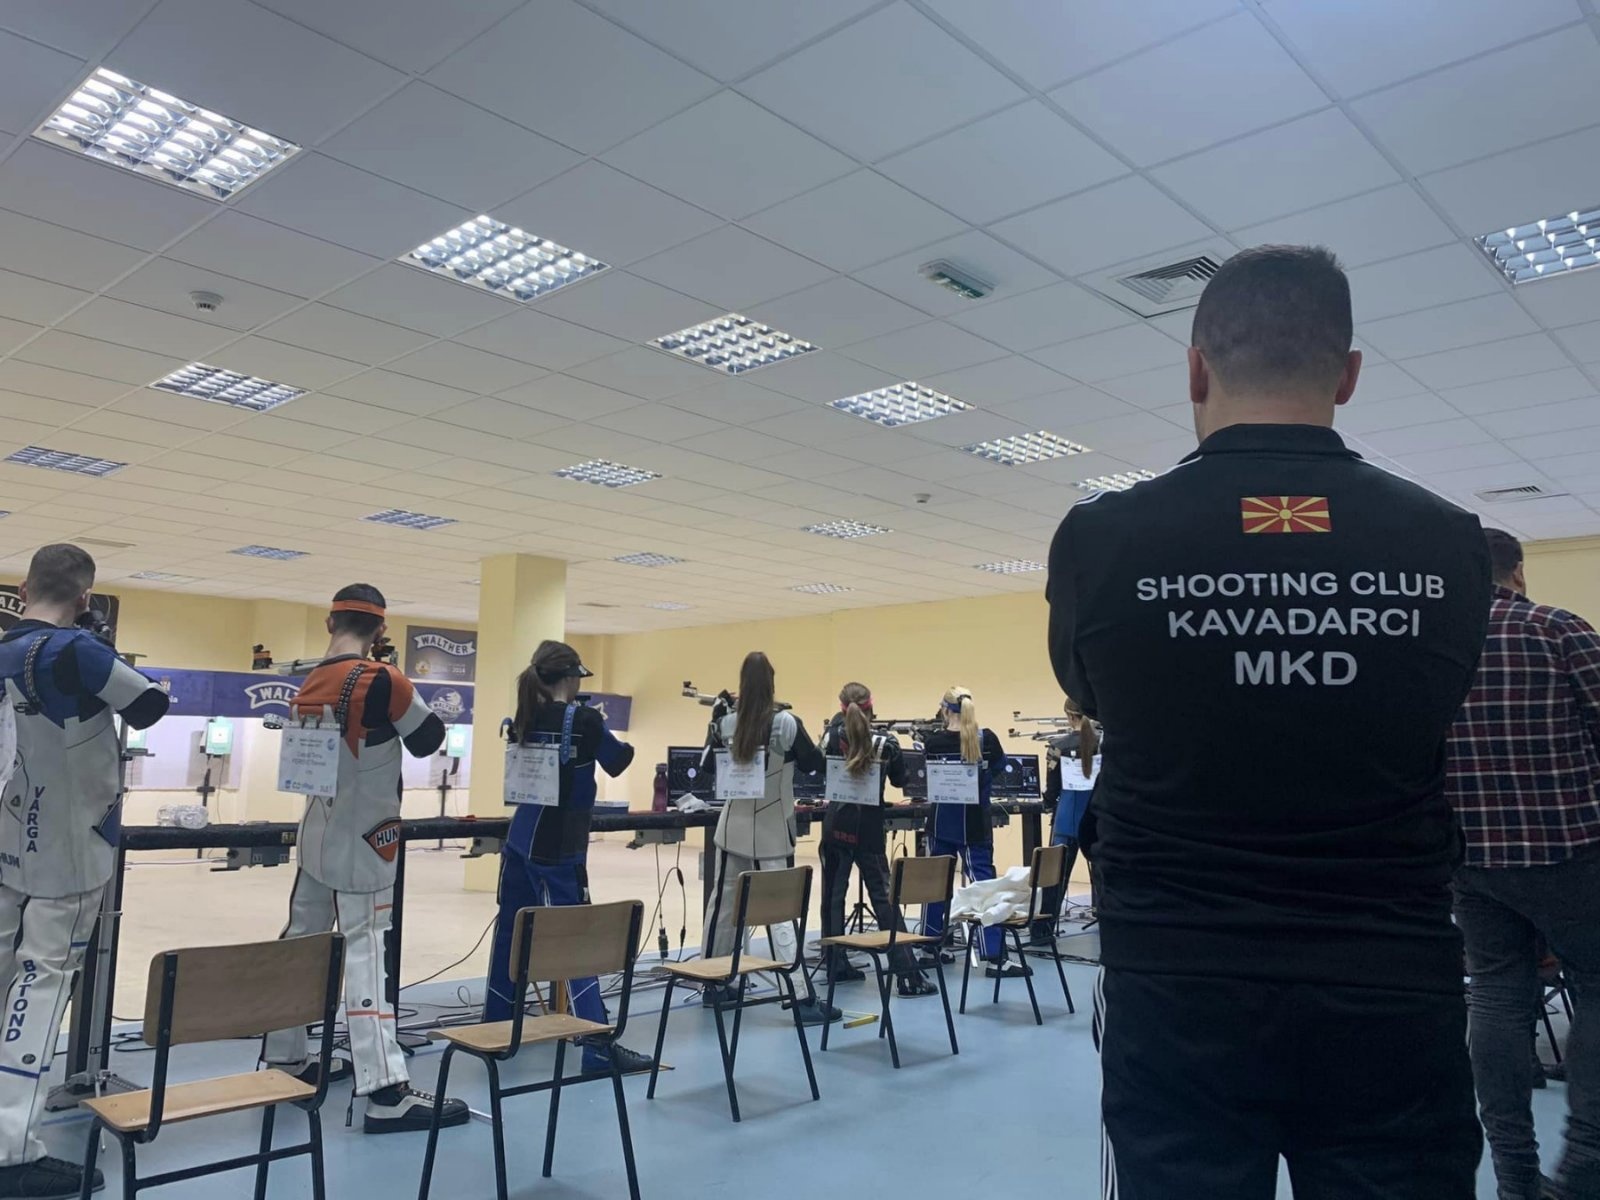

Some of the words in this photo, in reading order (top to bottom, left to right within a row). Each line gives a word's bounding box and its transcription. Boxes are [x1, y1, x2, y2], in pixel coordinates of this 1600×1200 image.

[1136, 571, 1339, 601] SHOOTING
[1349, 570, 1445, 599] CLUB
[1167, 607, 1421, 638] KAVADARCI
[420, 636, 469, 655] WALTHER
[1234, 650, 1358, 686] MKD
[26, 785, 46, 853] VARGA
[375, 827, 399, 848] HUN
[5, 959, 37, 1042] BOTOND
